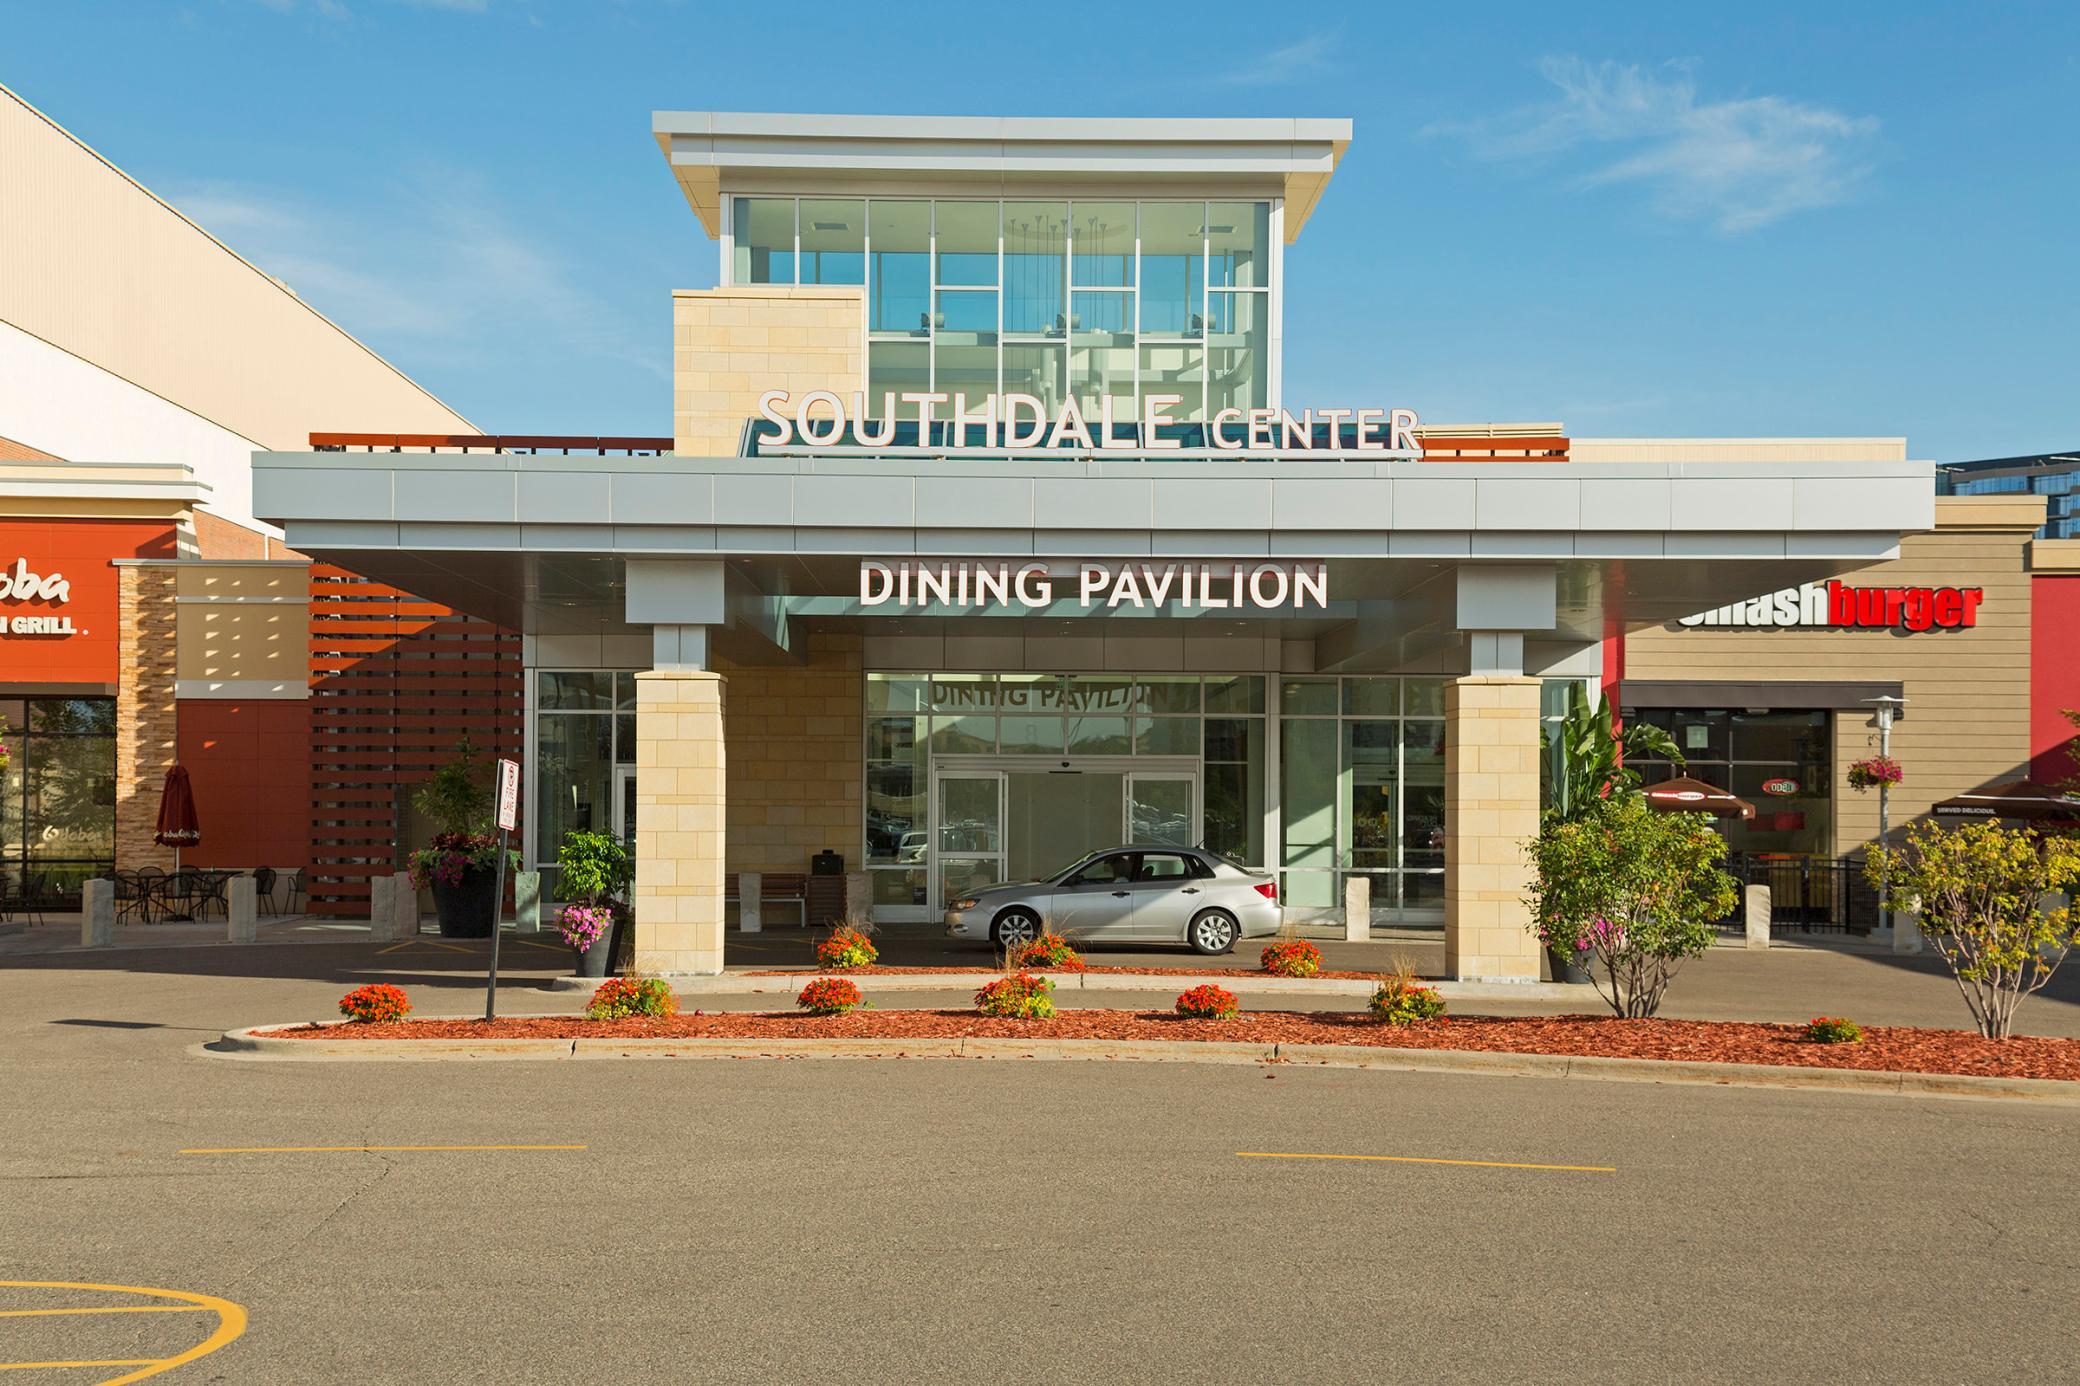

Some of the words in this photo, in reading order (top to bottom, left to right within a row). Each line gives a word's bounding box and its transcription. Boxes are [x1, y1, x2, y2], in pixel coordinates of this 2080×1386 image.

[758, 390, 1184, 449] SOUTHDALE
[1211, 407, 1422, 450] CENTER
[860, 562, 1052, 607] DINING
[1080, 563, 1328, 609] PAVILION
[1678, 580, 1984, 631] ashburger
[11, 616, 77, 634] GRILL
